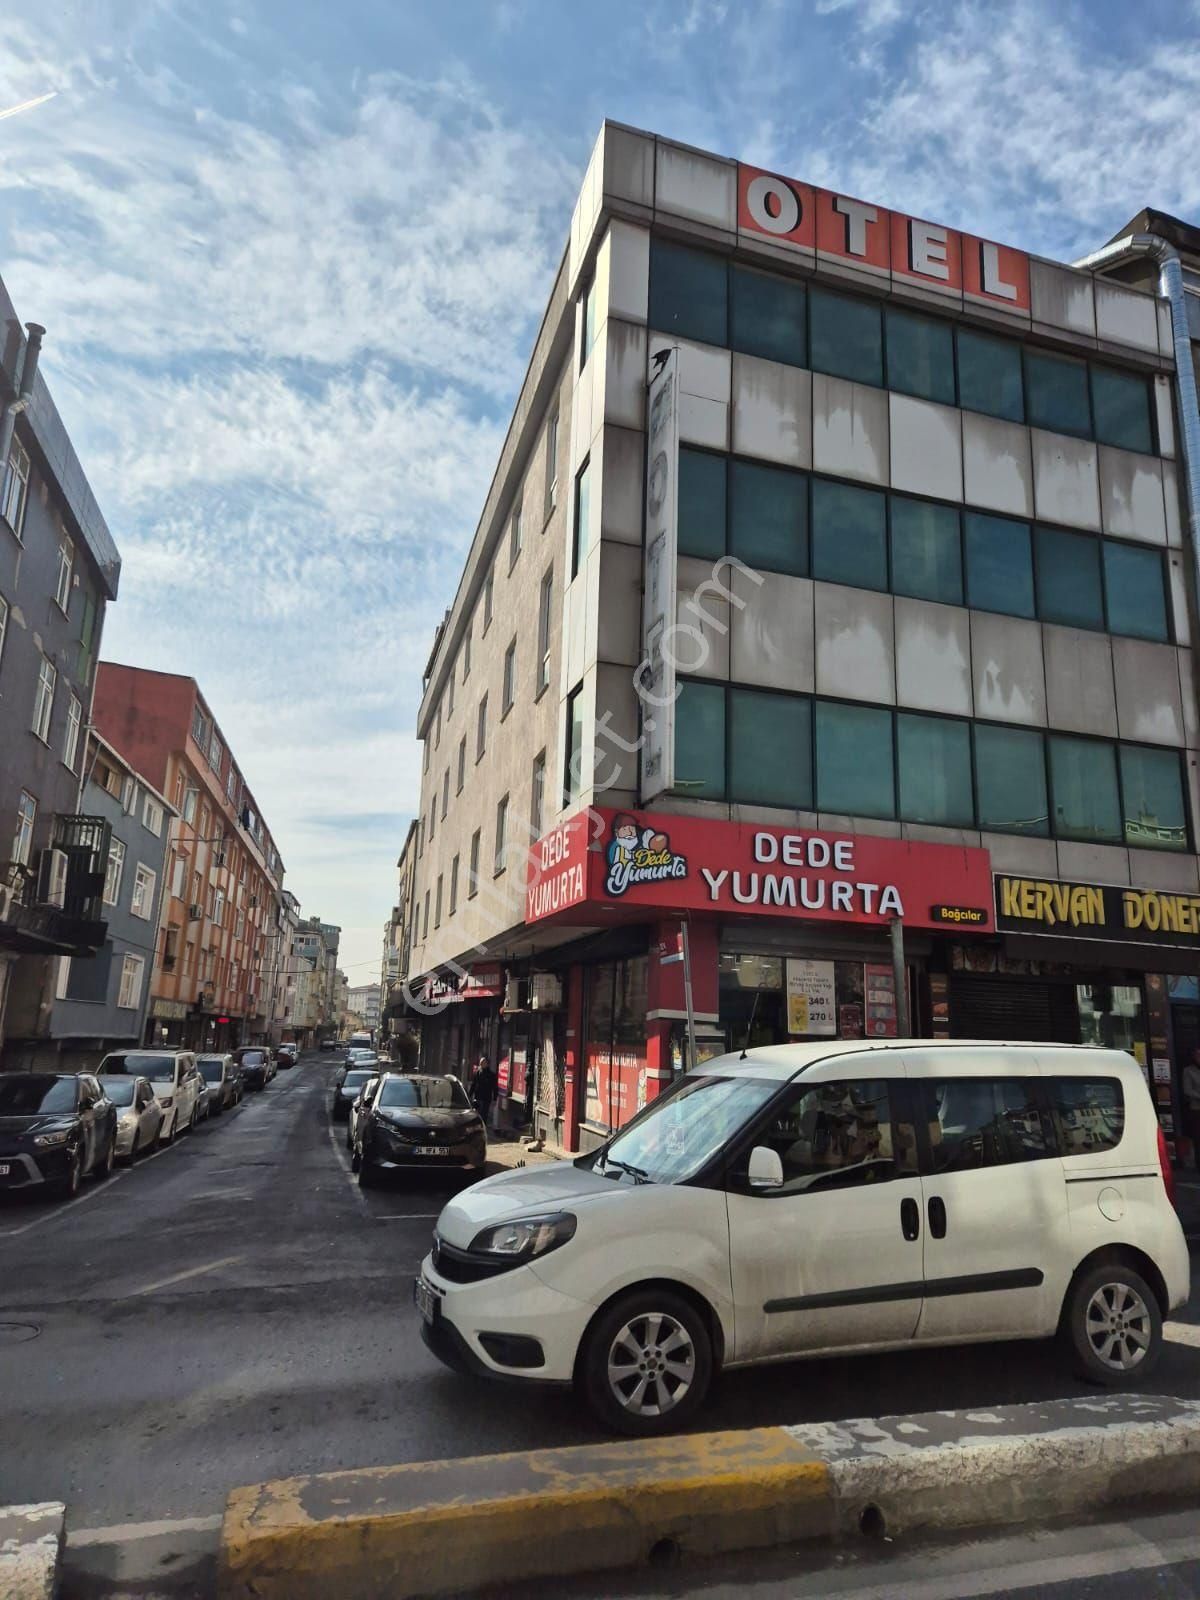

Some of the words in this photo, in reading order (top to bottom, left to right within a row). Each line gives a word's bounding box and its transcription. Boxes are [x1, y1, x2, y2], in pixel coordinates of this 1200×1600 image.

[747, 175, 1018, 301] OTEL
[541, 824, 571, 871] DEDE
[635, 848, 673, 866] Dede
[753, 831, 855, 871] DEDE
[528, 862, 584, 918] YUMURTA
[607, 856, 687, 894] Yumurta
[701, 868, 906, 917] YUMURTA
[940, 906, 982, 923] Bağcılar
[1000, 878, 1106, 928] KERVAN
